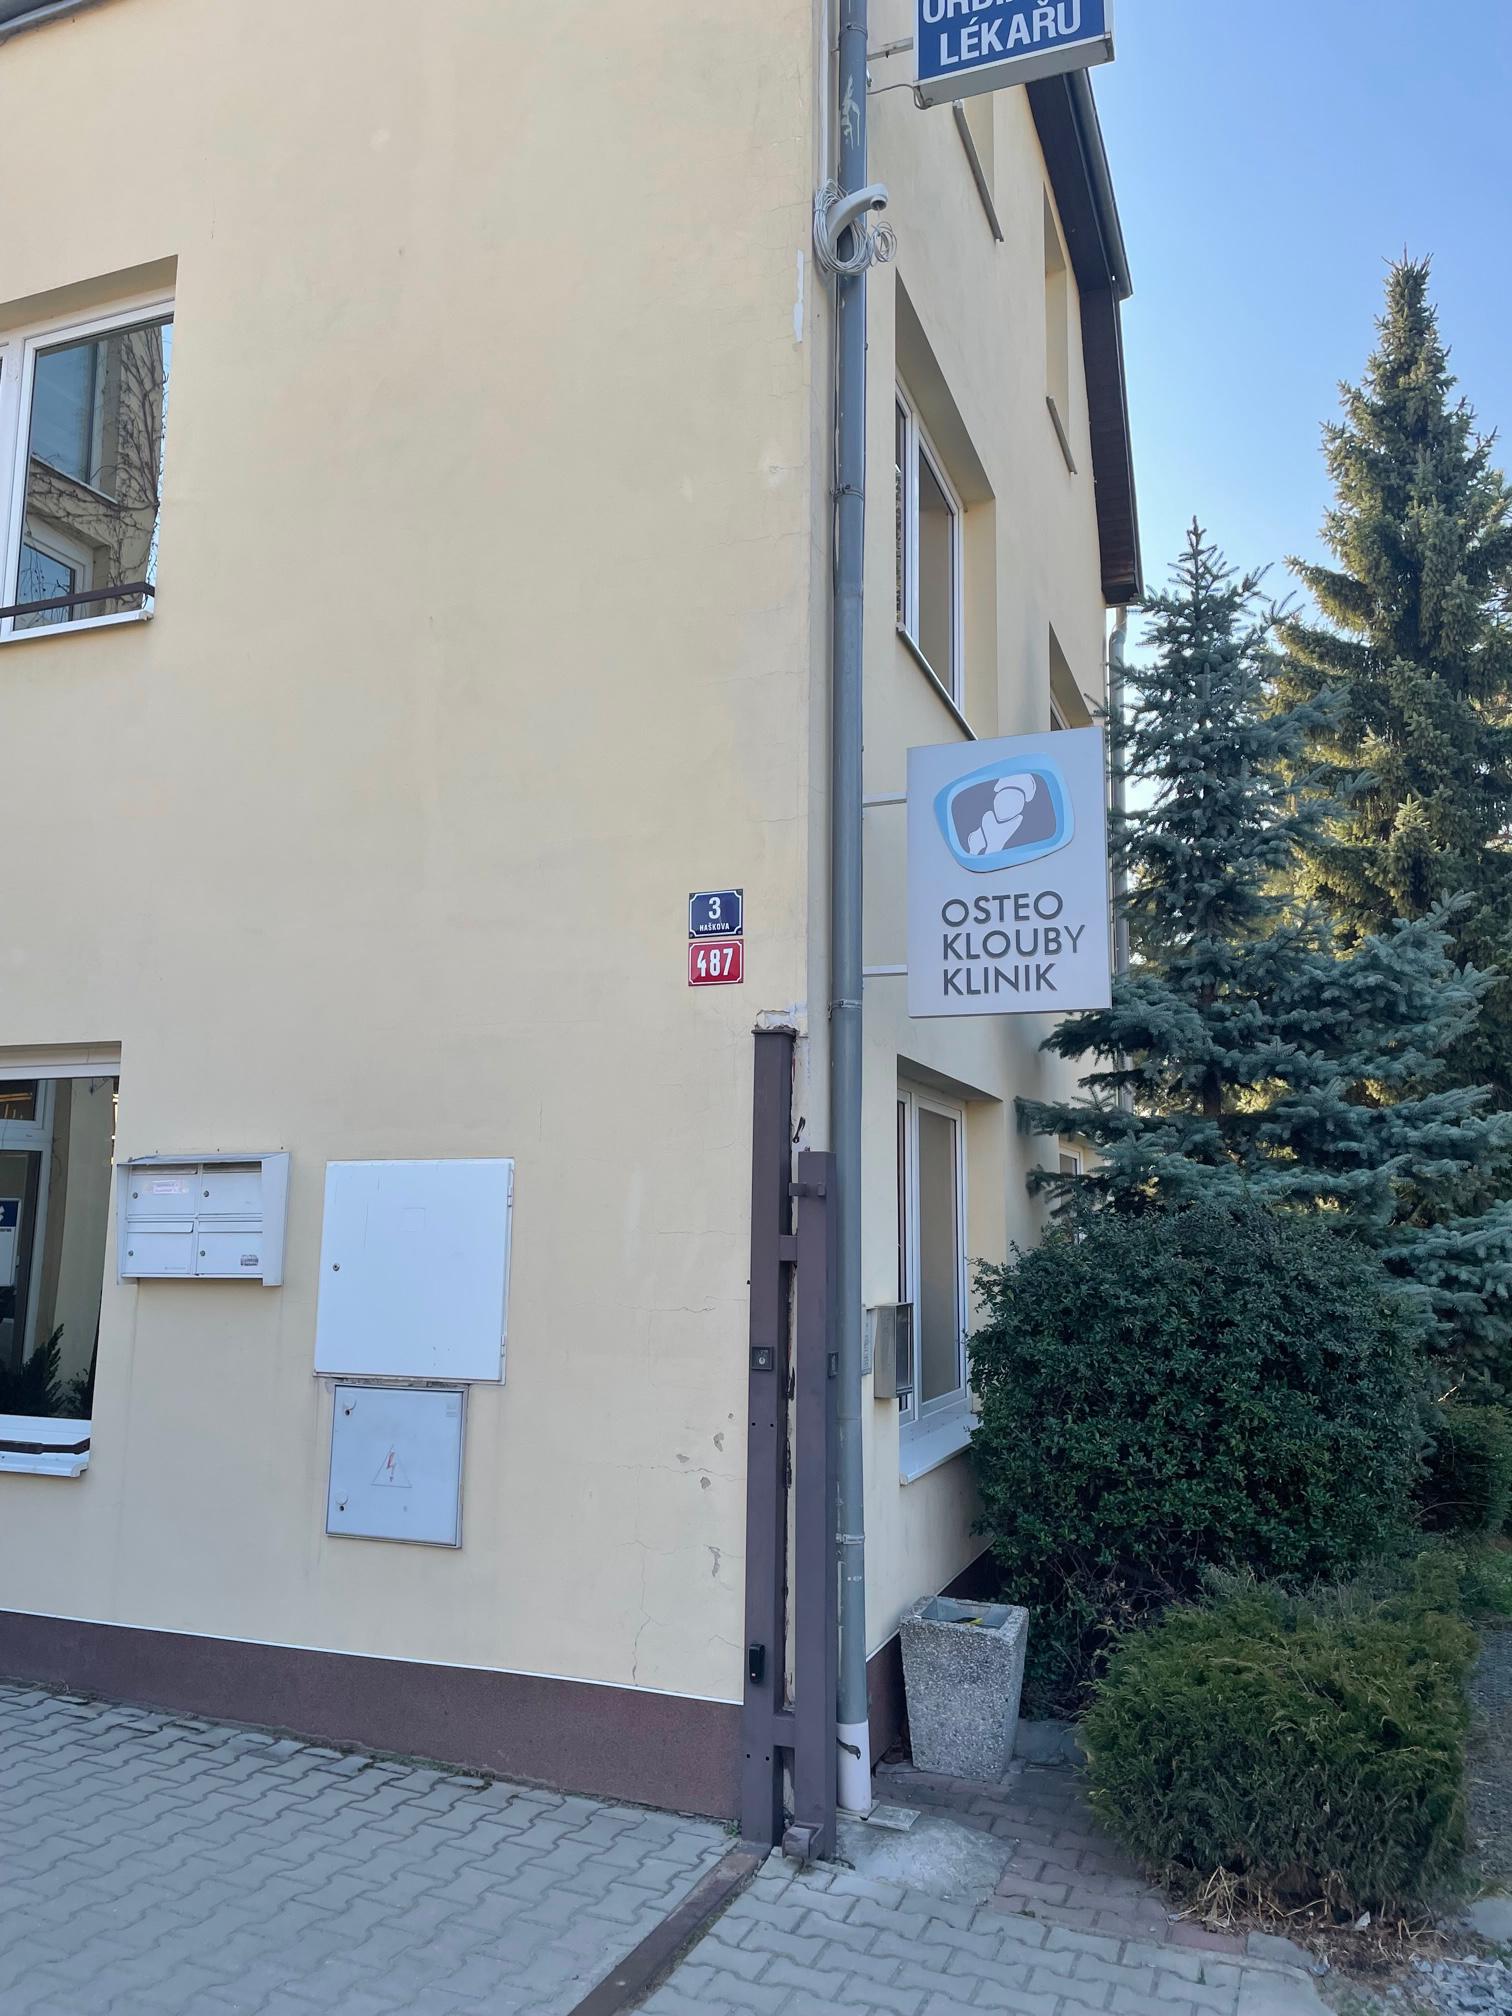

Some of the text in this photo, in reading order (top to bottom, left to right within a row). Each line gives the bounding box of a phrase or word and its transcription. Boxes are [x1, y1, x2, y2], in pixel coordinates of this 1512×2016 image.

[708, 897, 721, 919] 3
[942, 891, 1063, 927] OSTEO
[699, 922, 730, 931] HAŠKOVA
[943, 925, 1085, 960] KLOUBY
[697, 949, 733, 977] 487
[943, 964, 1058, 996] KLINIK
